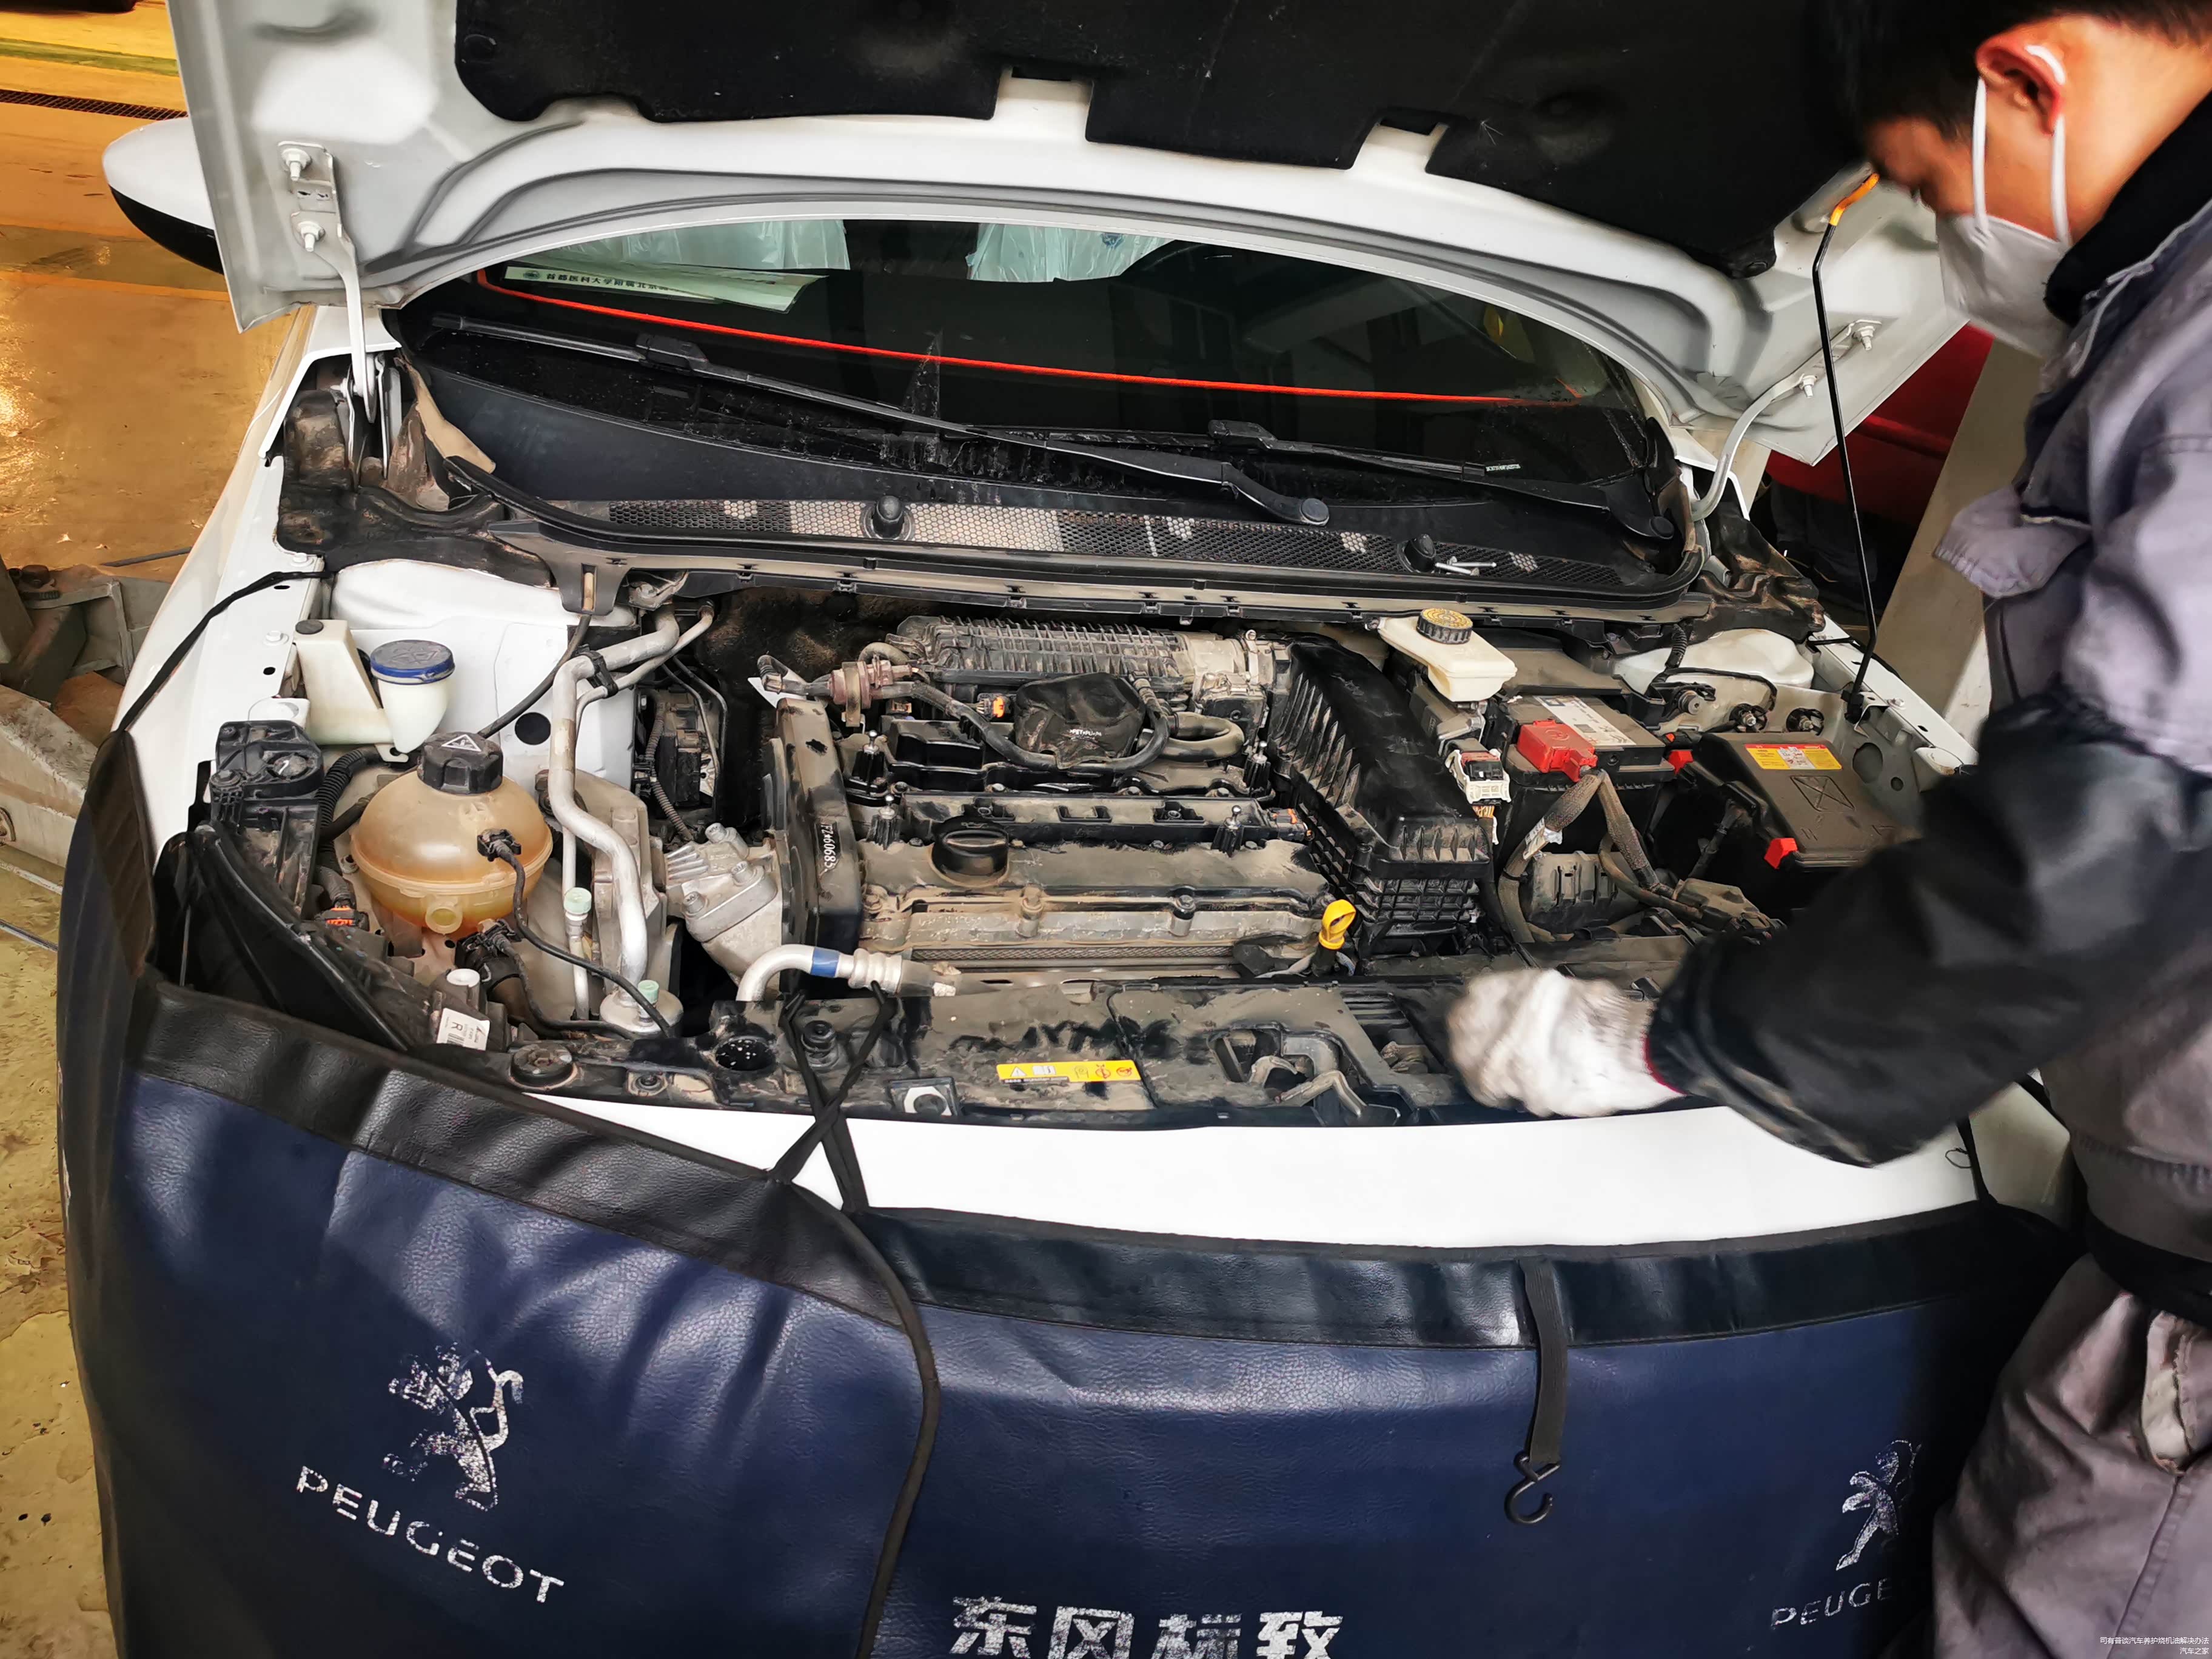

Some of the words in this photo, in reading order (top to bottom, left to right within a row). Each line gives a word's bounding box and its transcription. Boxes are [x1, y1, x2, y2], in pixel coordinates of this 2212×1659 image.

[297, 1466, 564, 1603] PEUGEOT
[950, 1596, 1343, 1658] 东风标致
